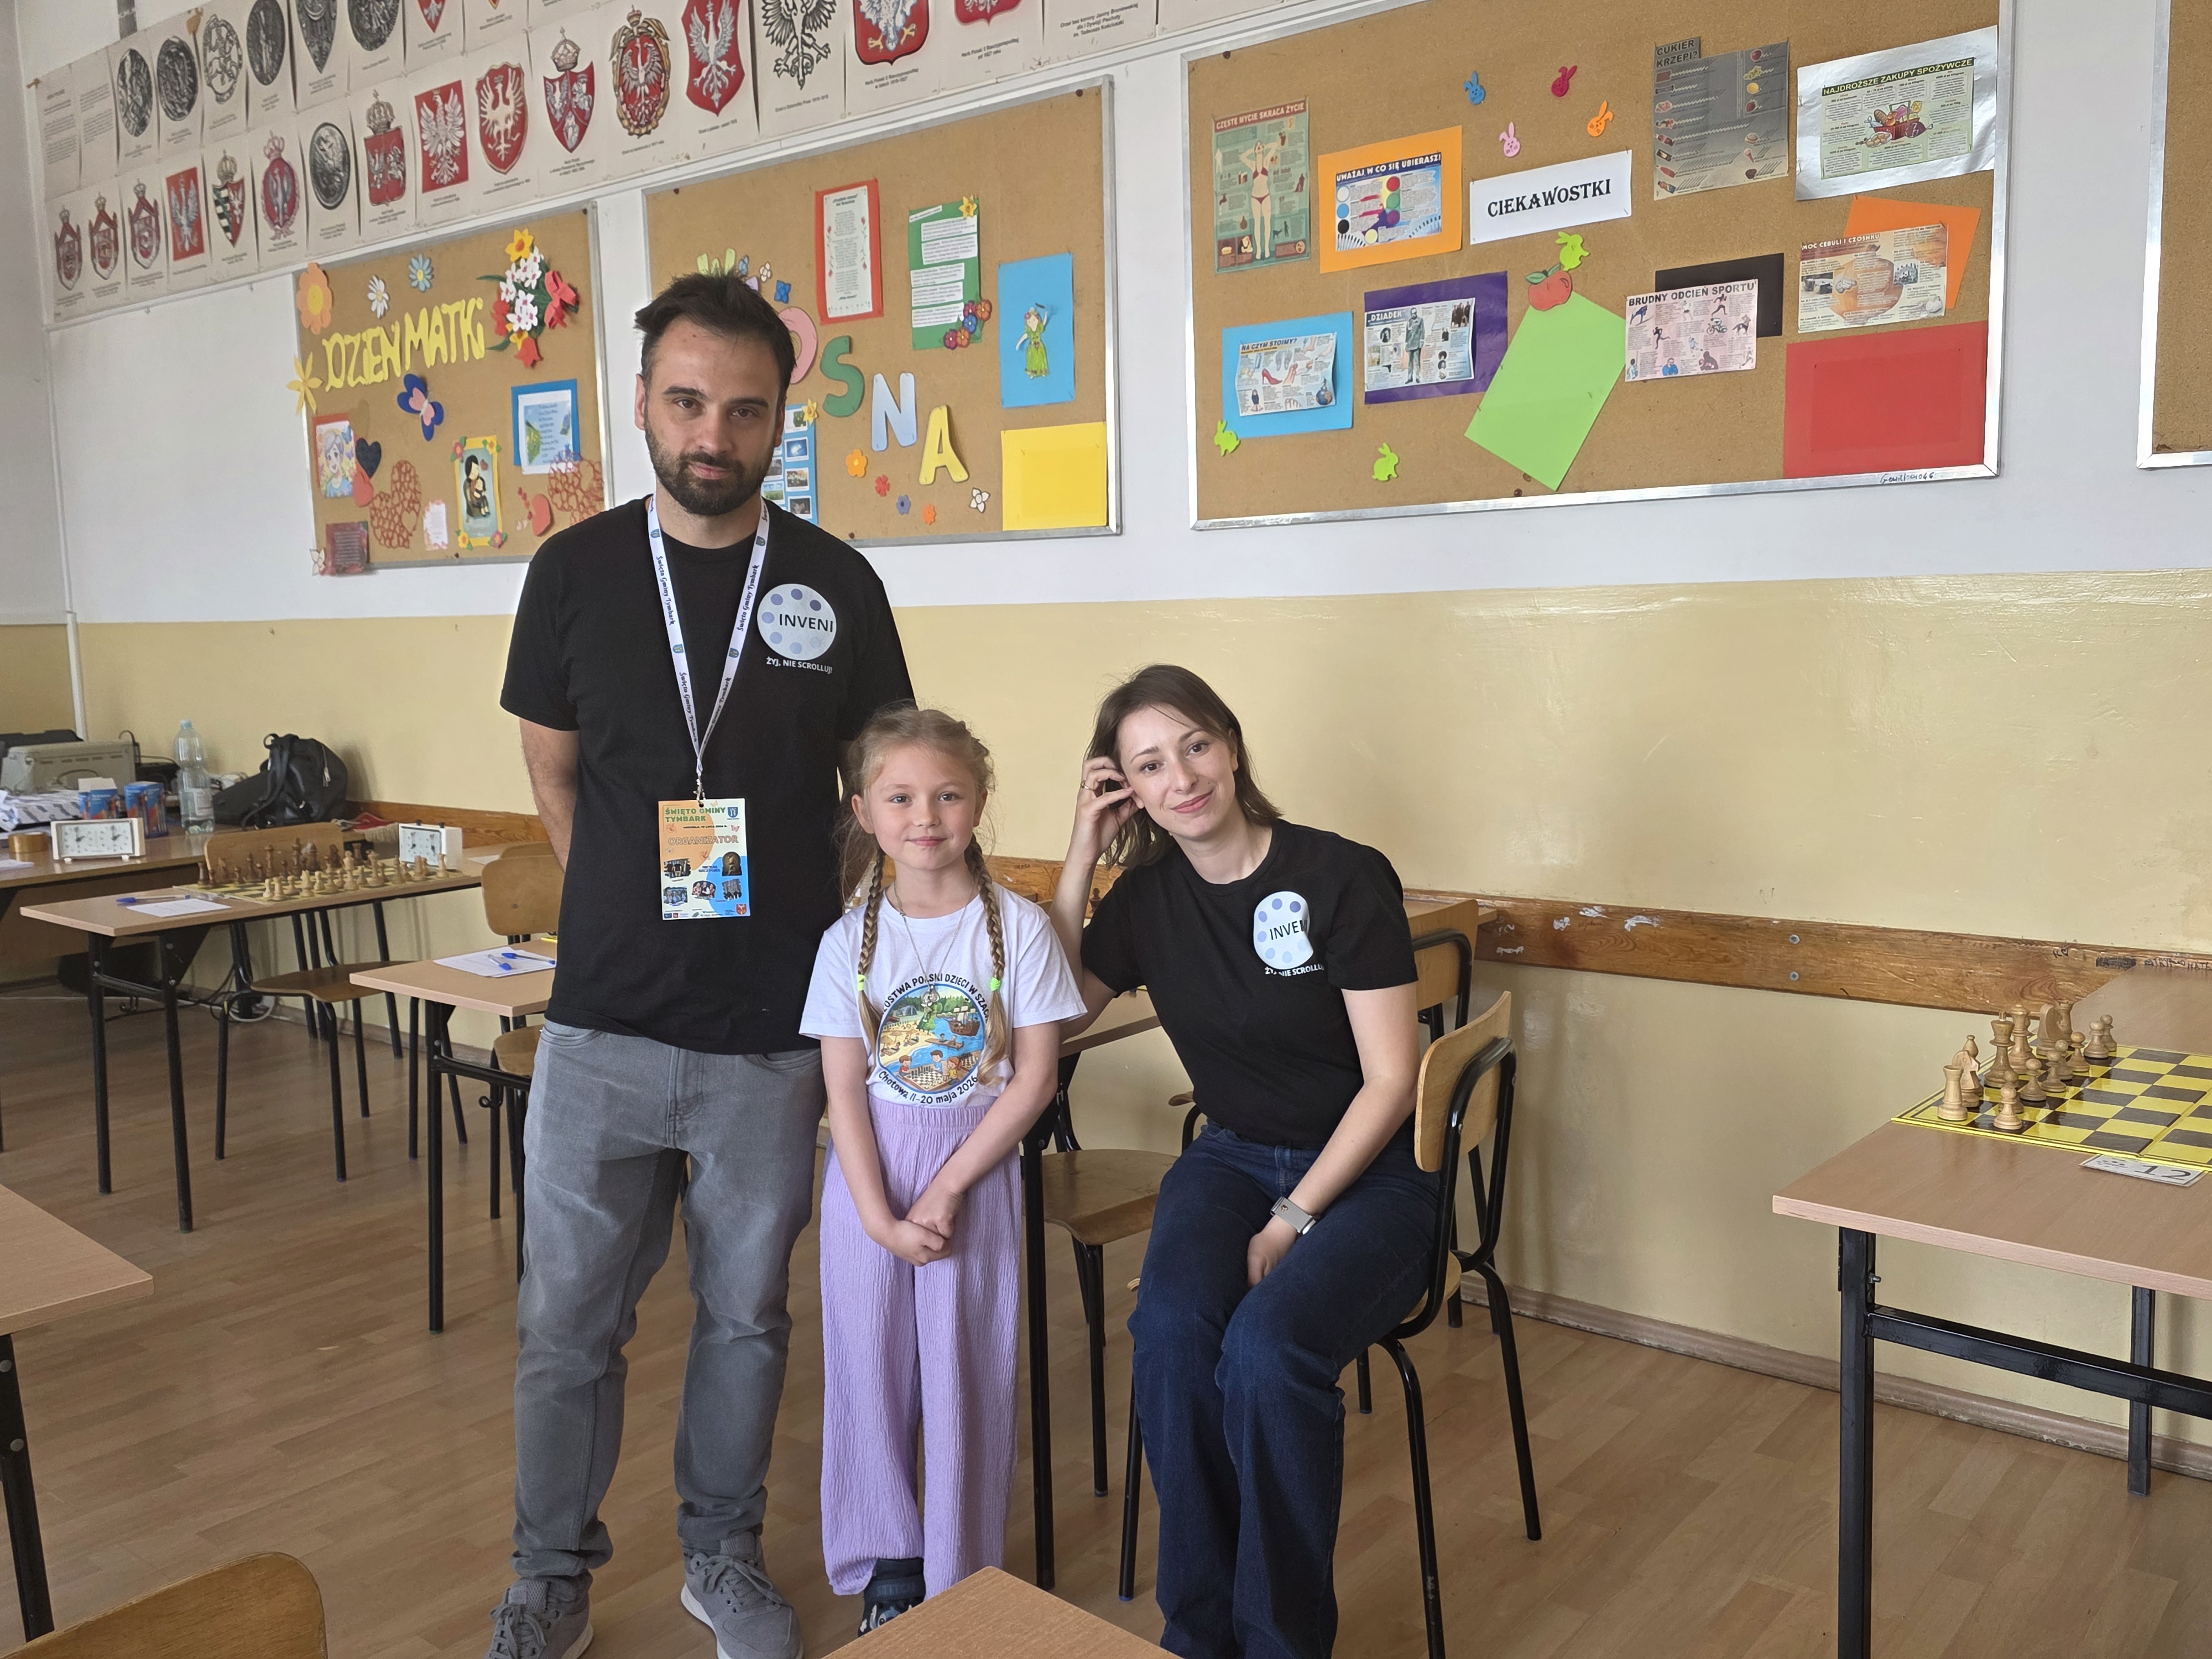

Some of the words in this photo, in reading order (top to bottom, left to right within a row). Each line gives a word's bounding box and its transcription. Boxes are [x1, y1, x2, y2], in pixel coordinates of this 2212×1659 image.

[1657, 39, 1694, 55] CUKIER
[1656, 50, 1698, 68] KRZEPI?
[1823, 78, 1879, 95] NAJDROŻSZE
[1880, 69, 1915, 83] ZAKUPY
[1917, 58, 1973, 75] SPOŻYWCZE
[1216, 117, 1238, 130] CZĘSTE
[1239, 113, 1258, 126] MYCIE
[1259, 107, 1285, 120] SKRACA
[1286, 102, 1305, 114] ŻYCIE
[1366, 167, 1374, 175] W
[1375, 164, 1386, 173] CO
[1388, 161, 1400, 171] SIĘ
[1402, 154, 1441, 168] UBIERASZ!
[1487, 179, 1611, 217] CIEKAWOSTKI
[1801, 242, 1818, 251] MOC
[1819, 239, 1841, 248] CEBULI
[1848, 233, 1880, 243] CZOSNKU
[1629, 293, 1669, 306] BRUDNY
[1671, 286, 1709, 300] ODCIEŃ
[1712, 282, 1755, 295] SPORTU
[1251, 341, 1269, 350] CZYM
[1269, 338, 1297, 347] STOIMY?
[742, 592, 753, 611] Gminy
[748, 565, 760, 591] Tymbark
[660, 577, 669, 597] Gminy
[665, 598, 676, 625] Tymbark
[779, 613, 833, 633] INVENI
[766, 656, 781, 667] ŻYJ,
[782, 659, 796, 667] NIE
[797, 661, 833, 675] SCROLLUJ!
[665, 807, 697, 816] ŚWIĘTO
[700, 806, 726, 815] GMINY
[667, 835, 739, 846] ORGANIZATOR
[945, 973, 970, 989] DZIECI
[968, 984, 978, 995] W
[936, 1092, 958, 1105] maja
[957, 1075, 978, 1096] 2026
[2133, 1164, 2192, 1181] 12
